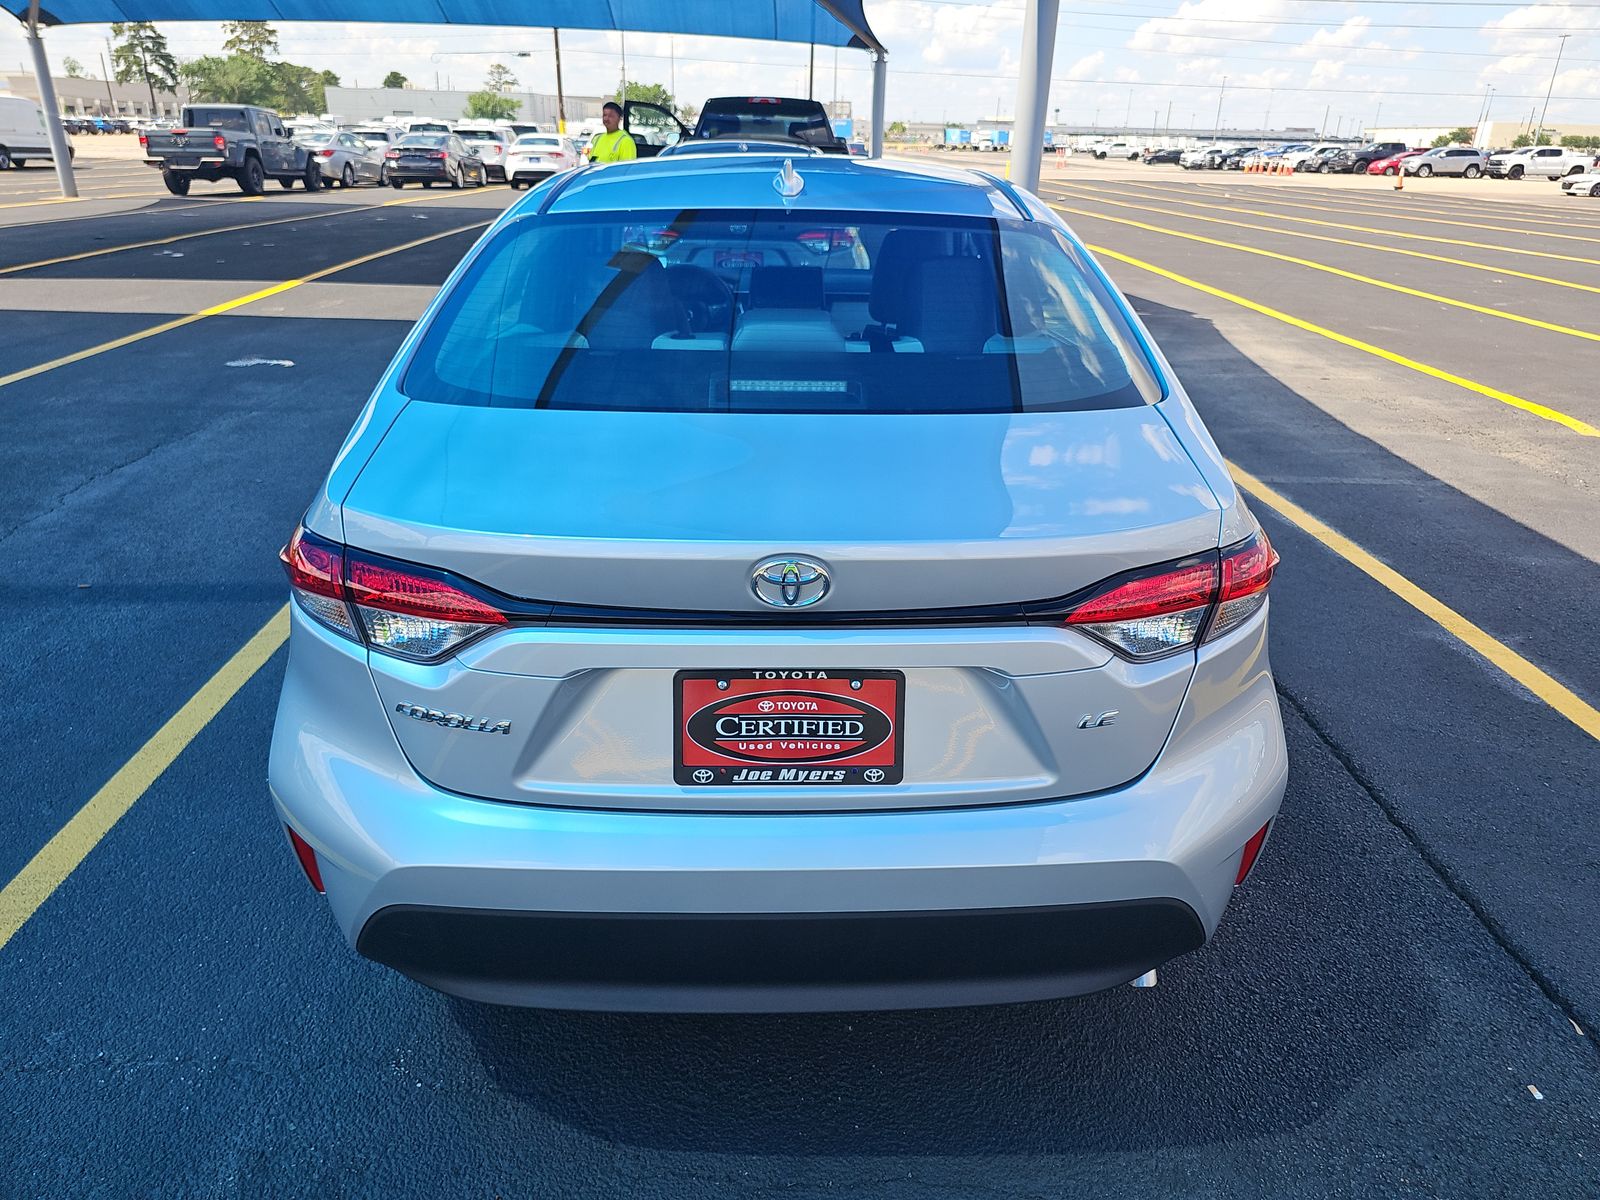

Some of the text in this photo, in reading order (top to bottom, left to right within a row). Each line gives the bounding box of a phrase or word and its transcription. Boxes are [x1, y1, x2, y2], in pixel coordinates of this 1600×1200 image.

[752, 671, 829, 680] TOYOTA
[776, 701, 819, 712] TOYOTA
[395, 700, 512, 735] COROLLA
[738, 741, 841, 750] Used Vehicles
[732, 768, 846, 782] Joe Myers
